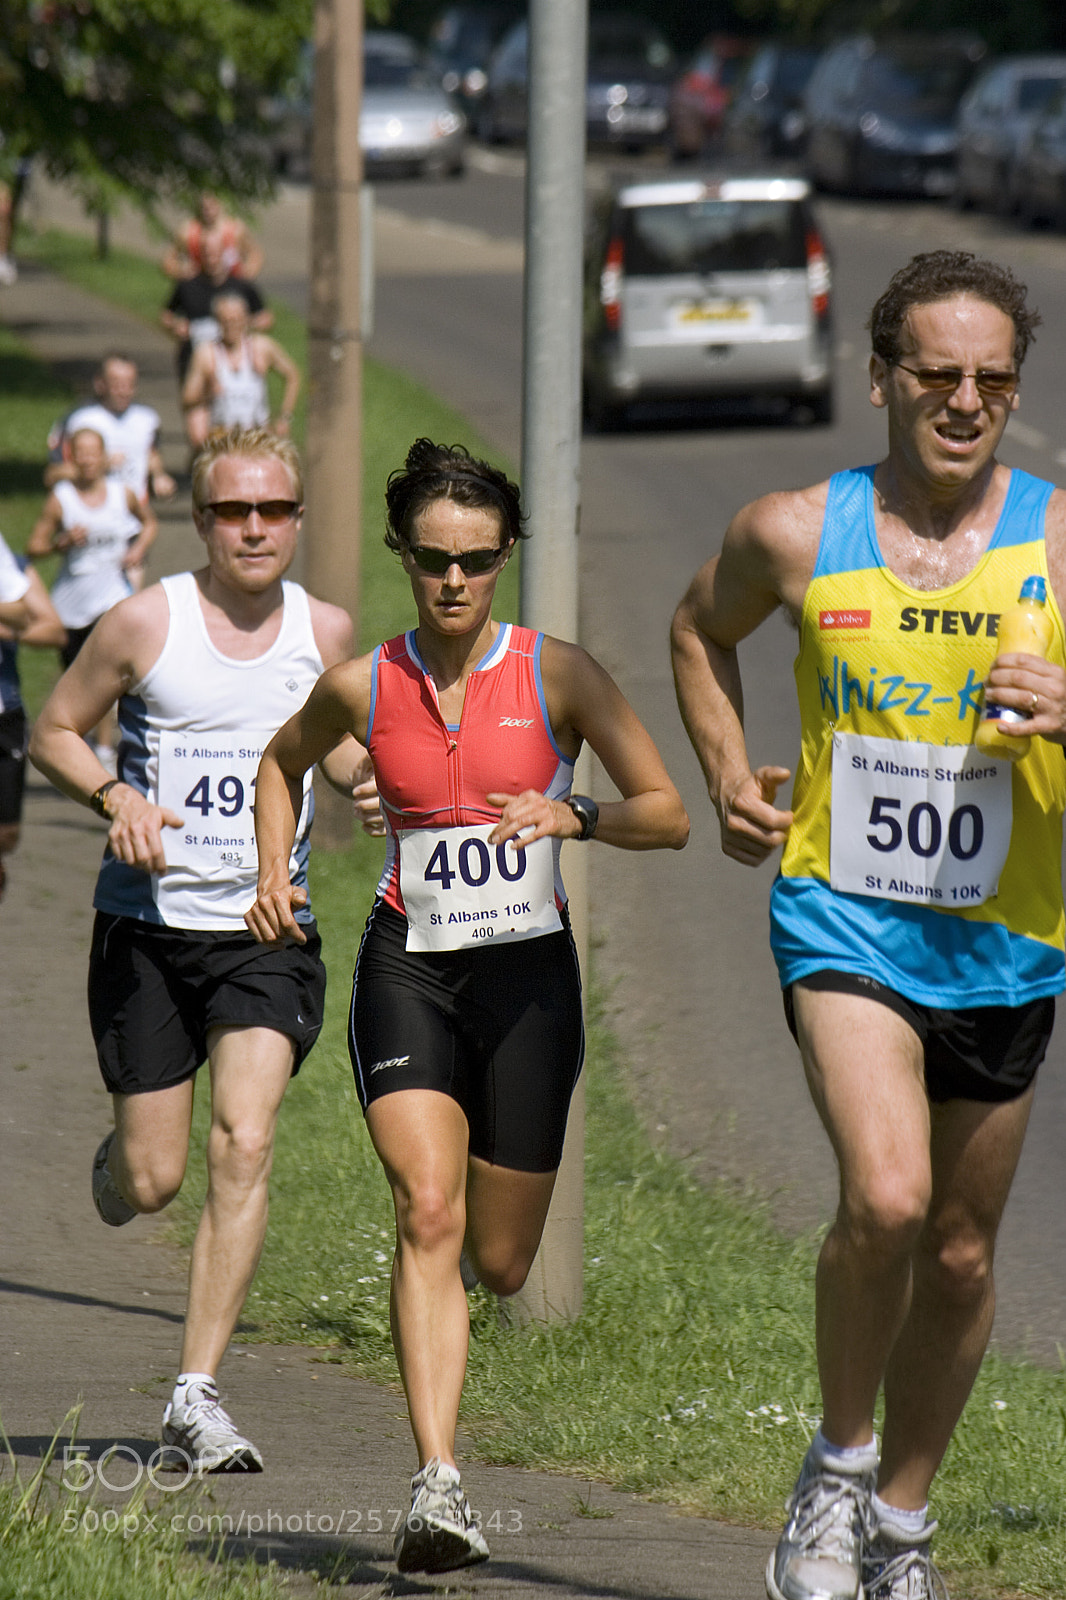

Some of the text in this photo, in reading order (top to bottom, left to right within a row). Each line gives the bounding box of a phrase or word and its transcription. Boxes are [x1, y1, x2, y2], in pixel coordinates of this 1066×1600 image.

[836, 613, 864, 625] Abbey
[899, 607, 1002, 638] STEVE
[174, 747, 187, 758] St
[192, 748, 234, 758] Albans
[852, 755, 997, 782] St Albans Striders
[184, 835, 198, 846] St
[202, 835, 245, 846] Albans
[866, 796, 984, 861] 500
[220, 852, 240, 862] 493
[424, 832, 527, 890] 400
[865, 875, 982, 900] St Albans 10K
[430, 901, 531, 925] St Albans 10K
[472, 927, 494, 939] 400
